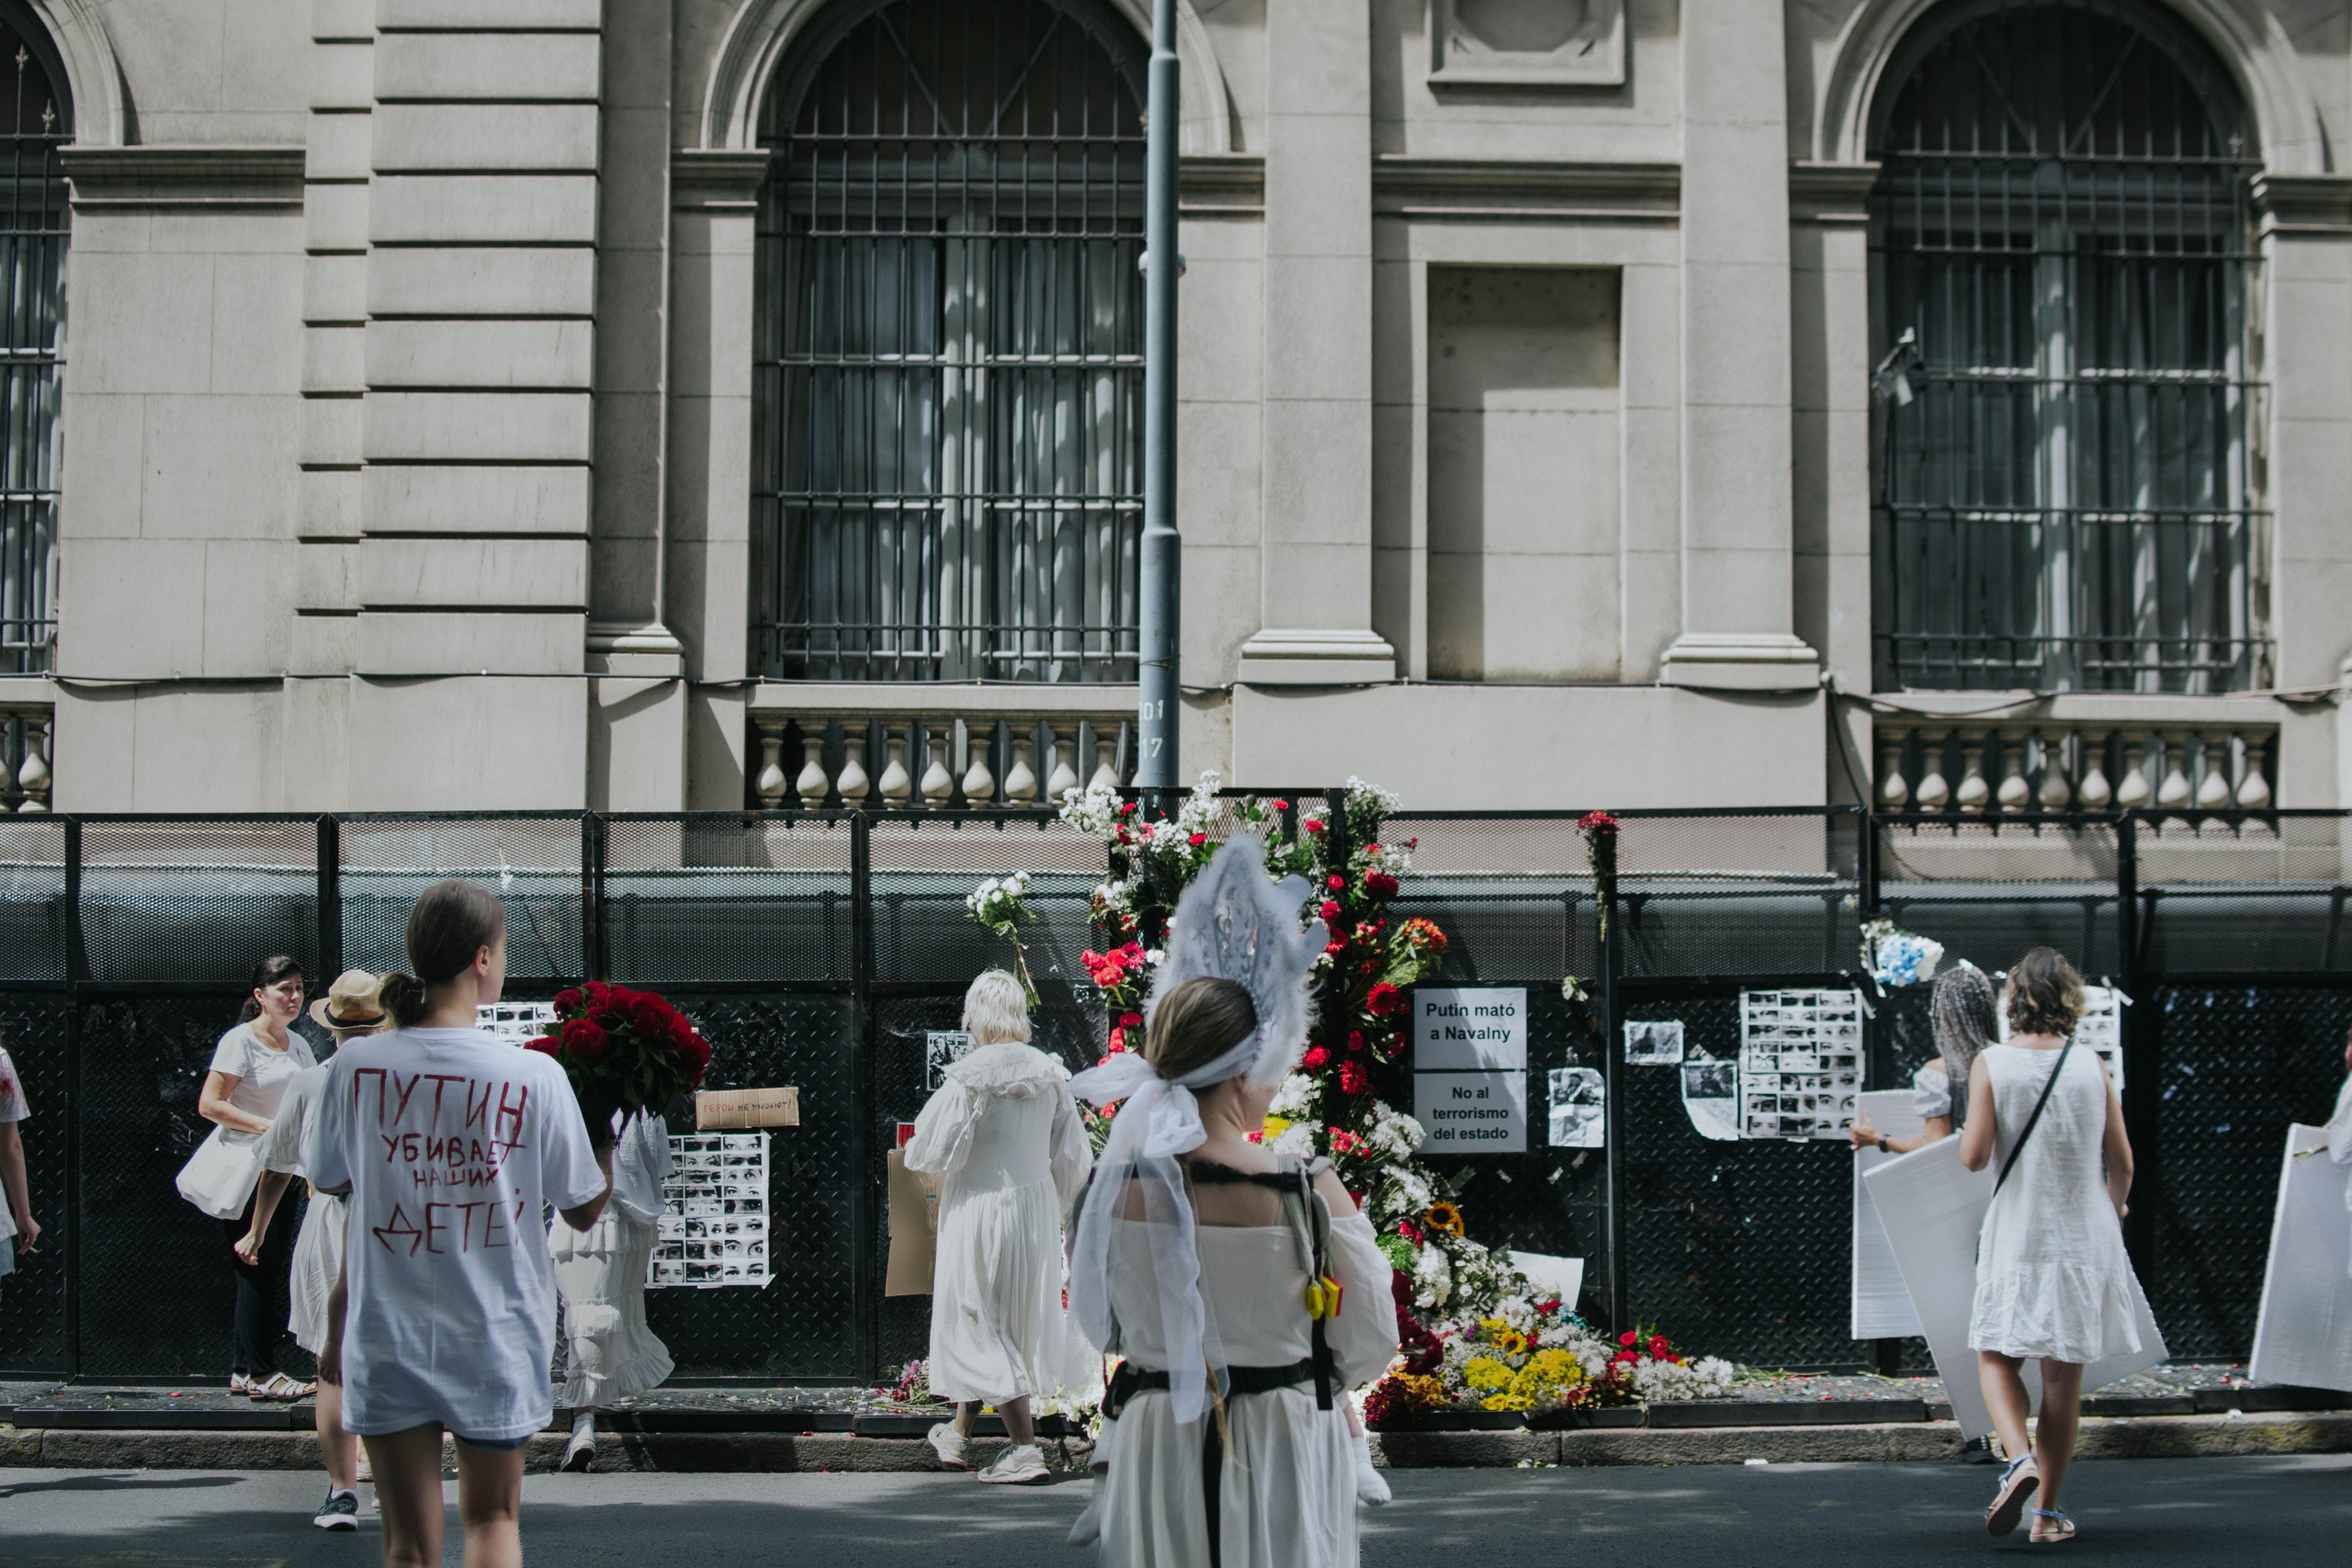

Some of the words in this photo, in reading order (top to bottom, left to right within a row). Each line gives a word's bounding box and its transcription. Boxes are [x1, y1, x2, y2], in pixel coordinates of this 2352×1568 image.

[1141, 738, 1163, 758] 17
[1426, 1002, 1469, 1017] Putin
[1474, 1002, 1516, 1017] mató
[1430, 1030, 1440, 1040] a
[1444, 1026, 1511, 1043] Navalny
[1452, 1087, 1473, 1100] No
[1476, 1086, 1489, 1100] al
[354, 1067, 528, 1142] ПУТИН
[703, 1103, 734, 1113] ГЕРОИ
[737, 1103, 749, 1111] НЕ
[1432, 1107, 1509, 1120] terrorismo
[1433, 1127, 1455, 1140] del
[1459, 1127, 1509, 1140] estado
[380, 1133, 526, 1169] УБИВАЕТ
[413, 1168, 500, 1190] НАШИХ
